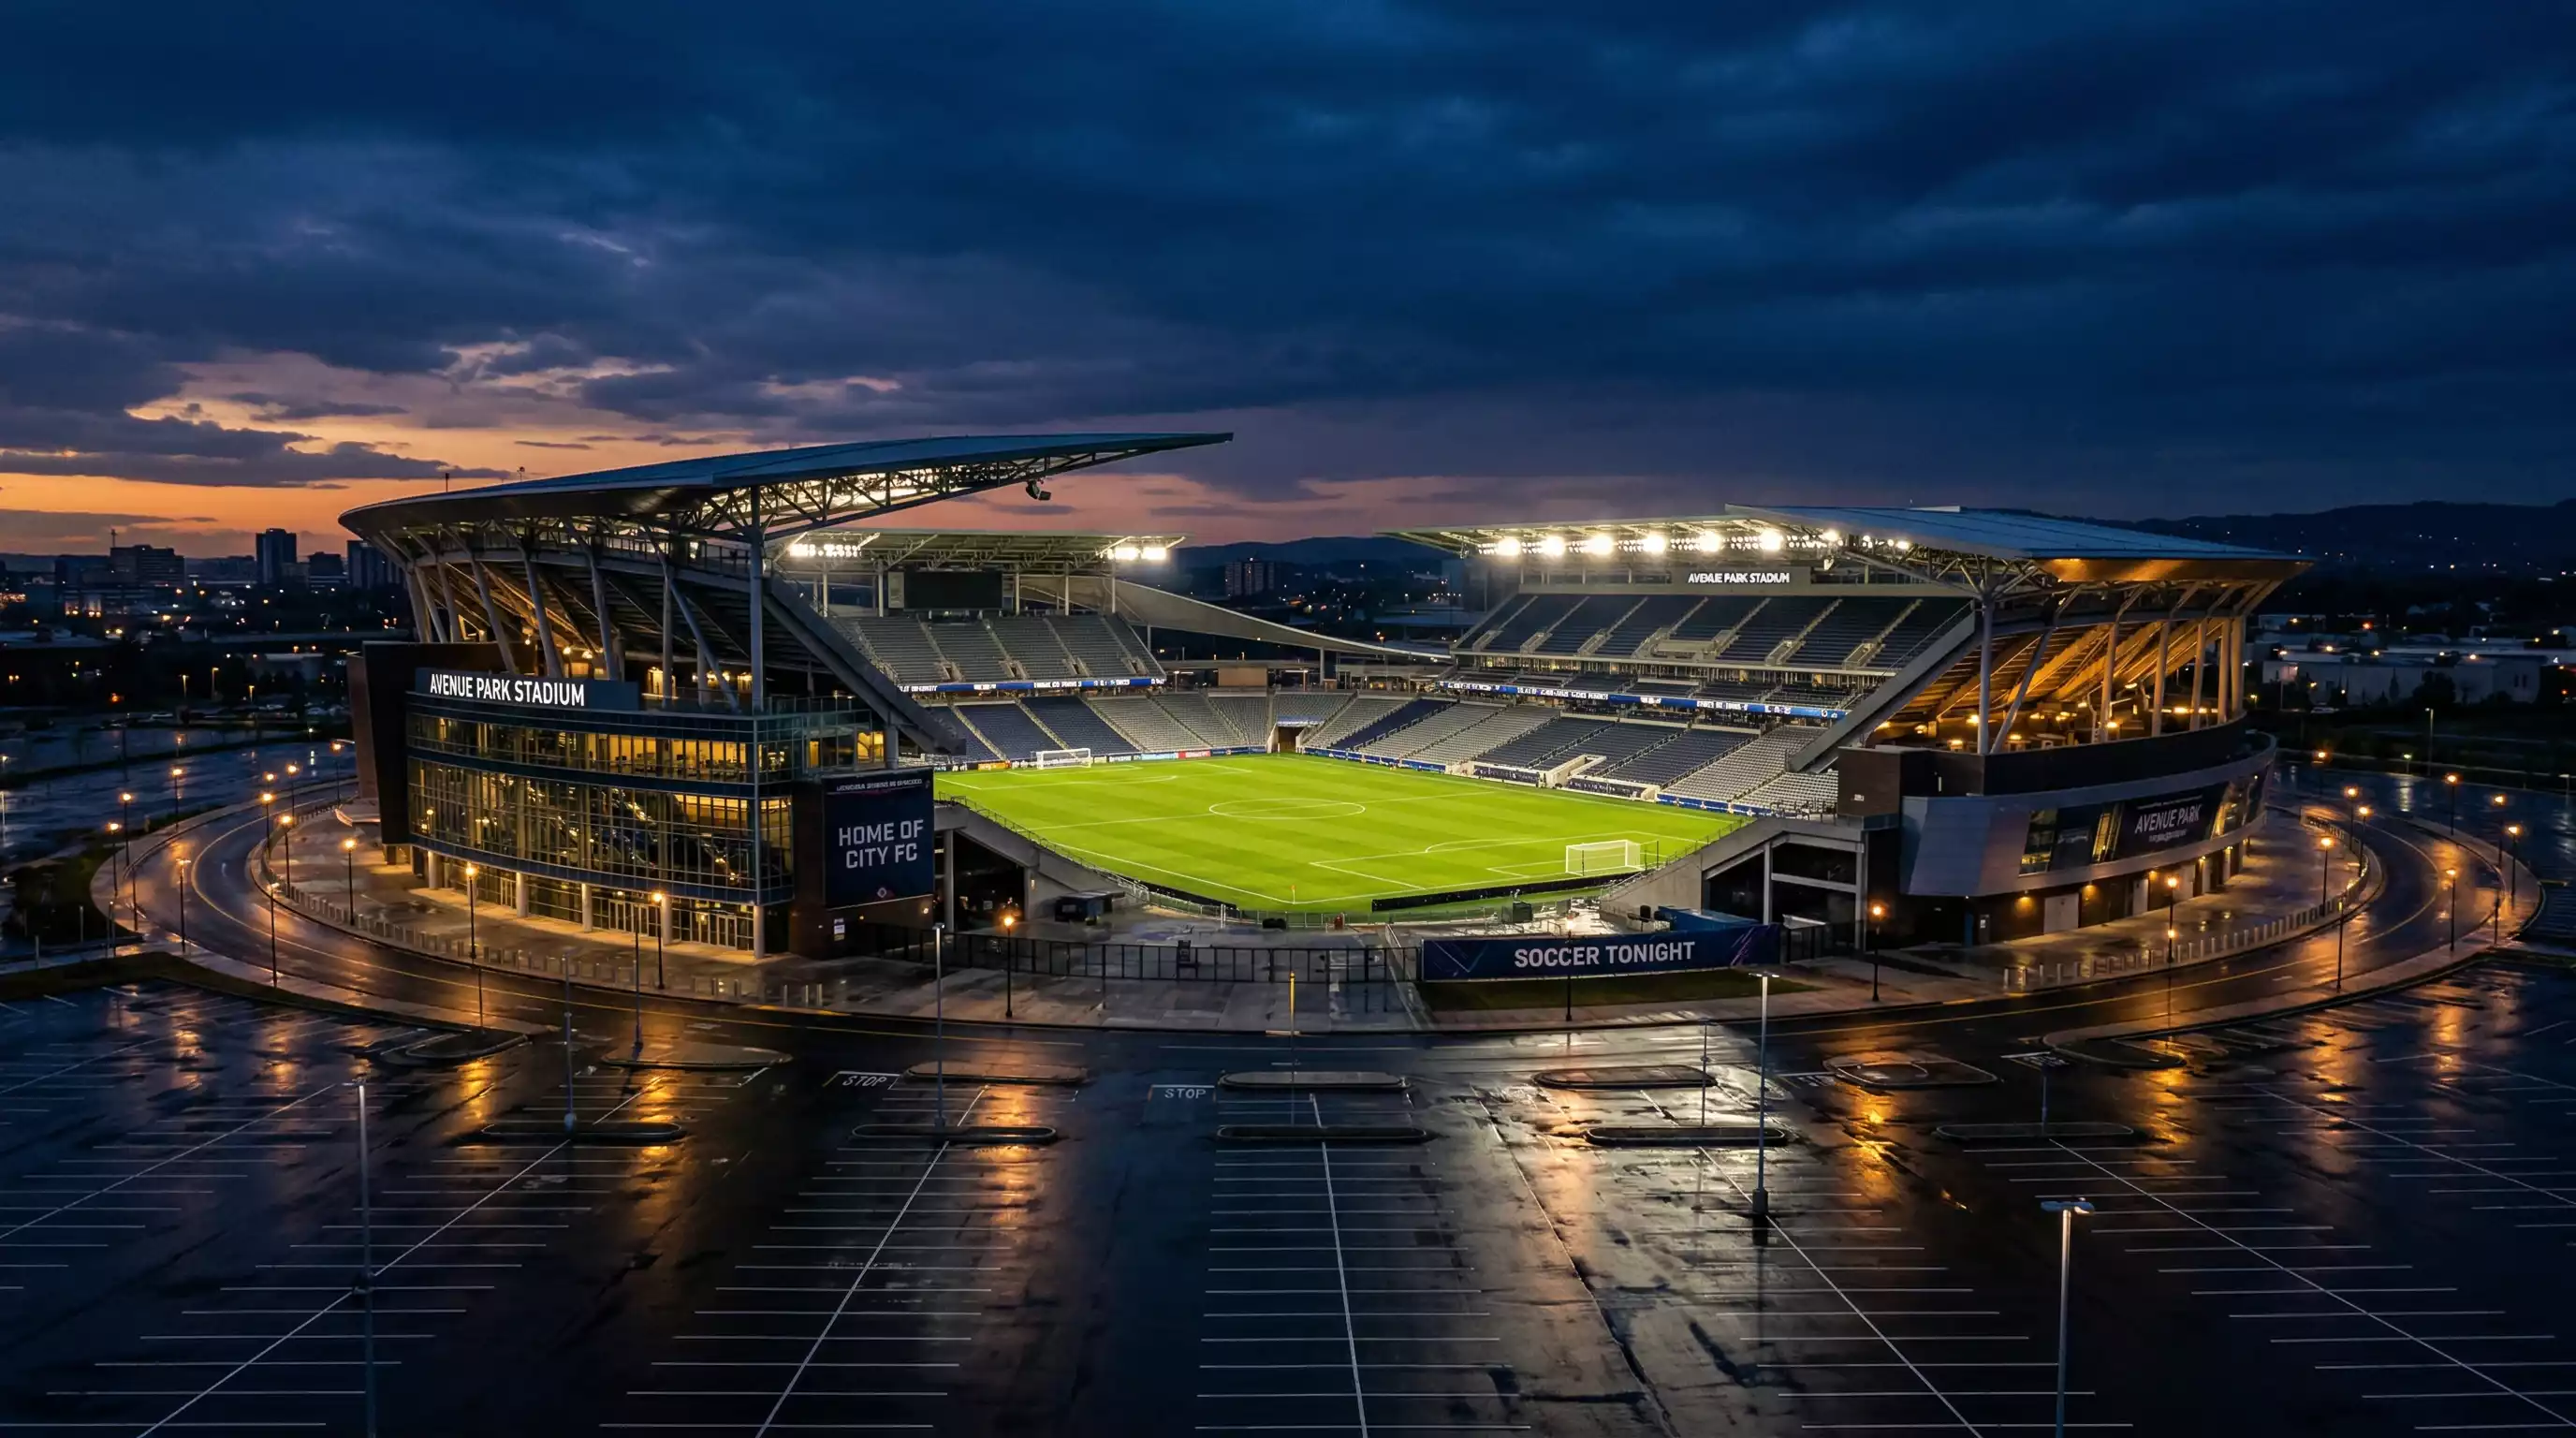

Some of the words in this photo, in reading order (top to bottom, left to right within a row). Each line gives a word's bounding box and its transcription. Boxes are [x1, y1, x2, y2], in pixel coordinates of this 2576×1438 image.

[1723, 572, 1749, 583] PARK
[430, 673, 474, 697] AVENUE
[476, 678, 511, 701] PARK
[514, 680, 585, 707] STADIUM
[2134, 808, 2177, 834] AVENUE
[2176, 804, 2203, 826] PARK
[839, 822, 895, 846] HOME
[900, 819, 924, 839] OF
[845, 845, 888, 869] CITY
[894, 843, 918, 863] FC
[1514, 946, 1600, 968] SOCCER
[1605, 941, 1695, 964] TONIGHT
[842, 1075, 887, 1087] STOP
[1164, 1088, 1207, 1099] STOP
